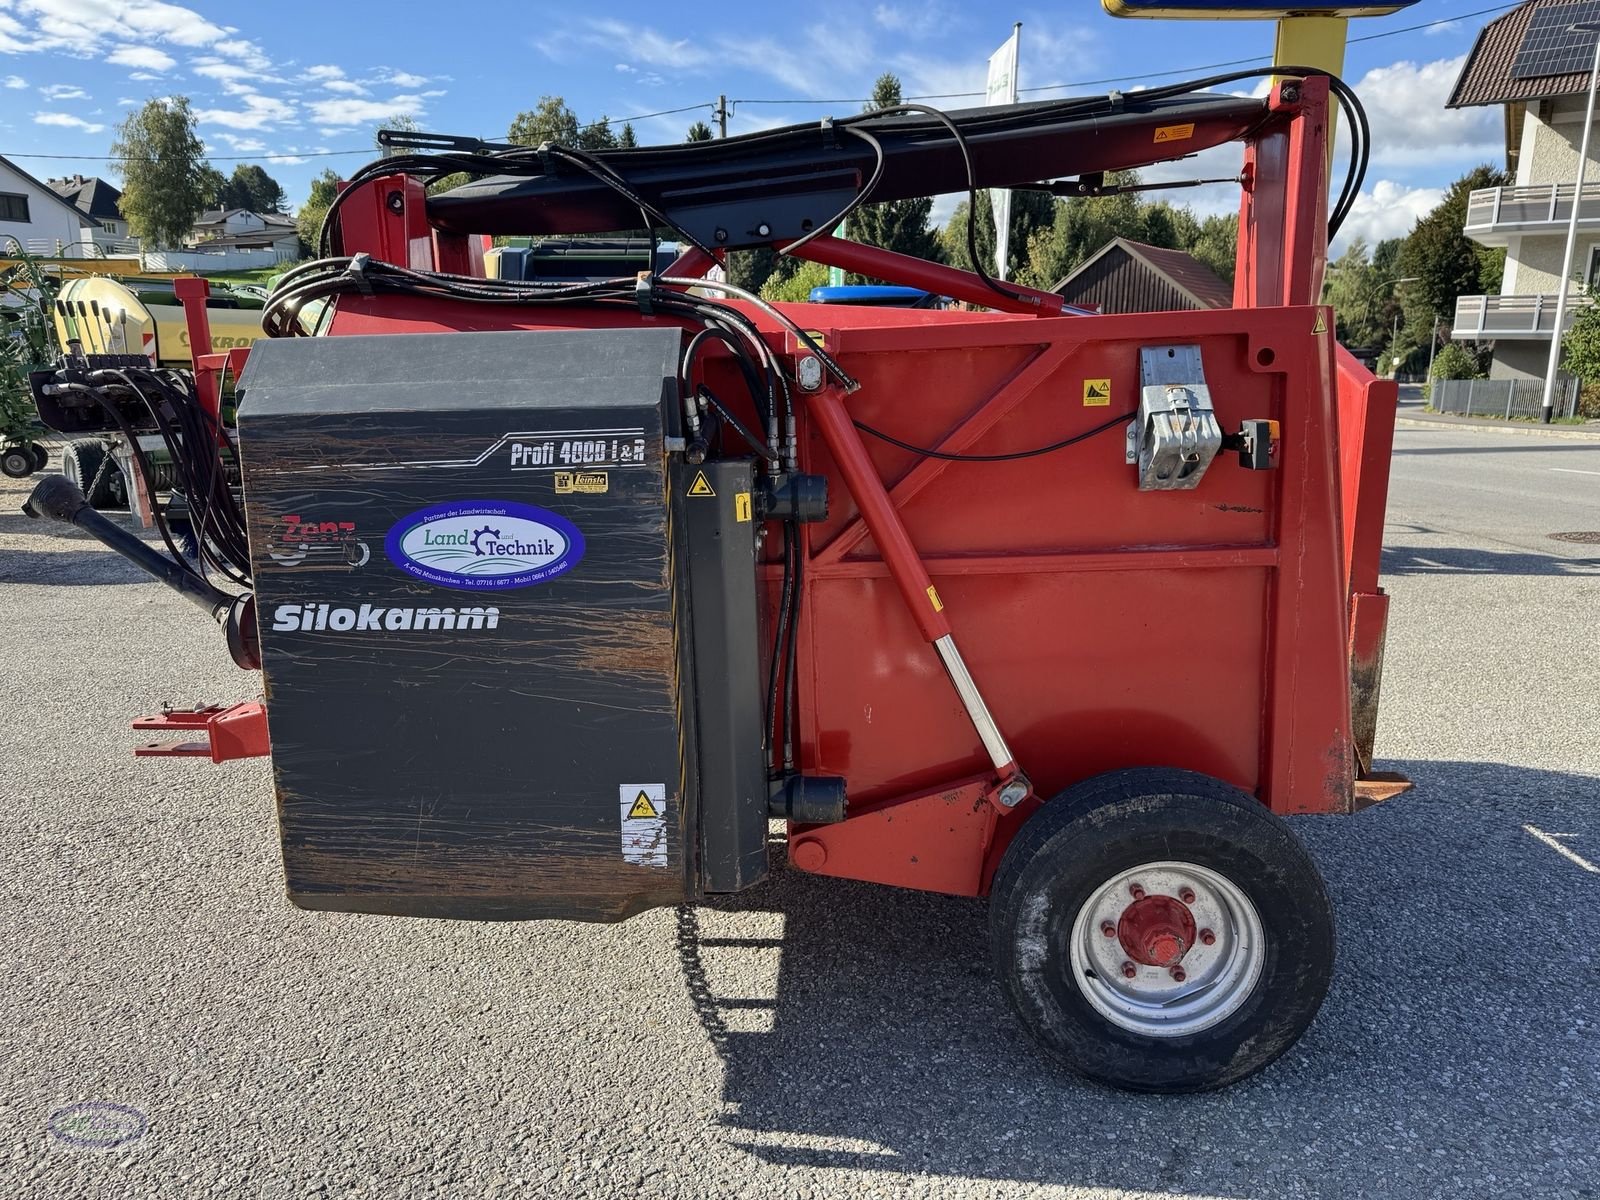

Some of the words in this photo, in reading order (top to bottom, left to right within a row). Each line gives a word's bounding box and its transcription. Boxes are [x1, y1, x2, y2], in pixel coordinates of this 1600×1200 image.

[510, 442, 554, 466] Profi
[559, 440, 606, 464] 4000
[423, 512, 447, 523] Partner
[281, 515, 355, 542] Zenz
[424, 529, 469, 546] Land
[486, 539, 555, 556] Technik
[514, 575, 532, 584] Mobil
[272, 603, 500, 632] Silokamm
